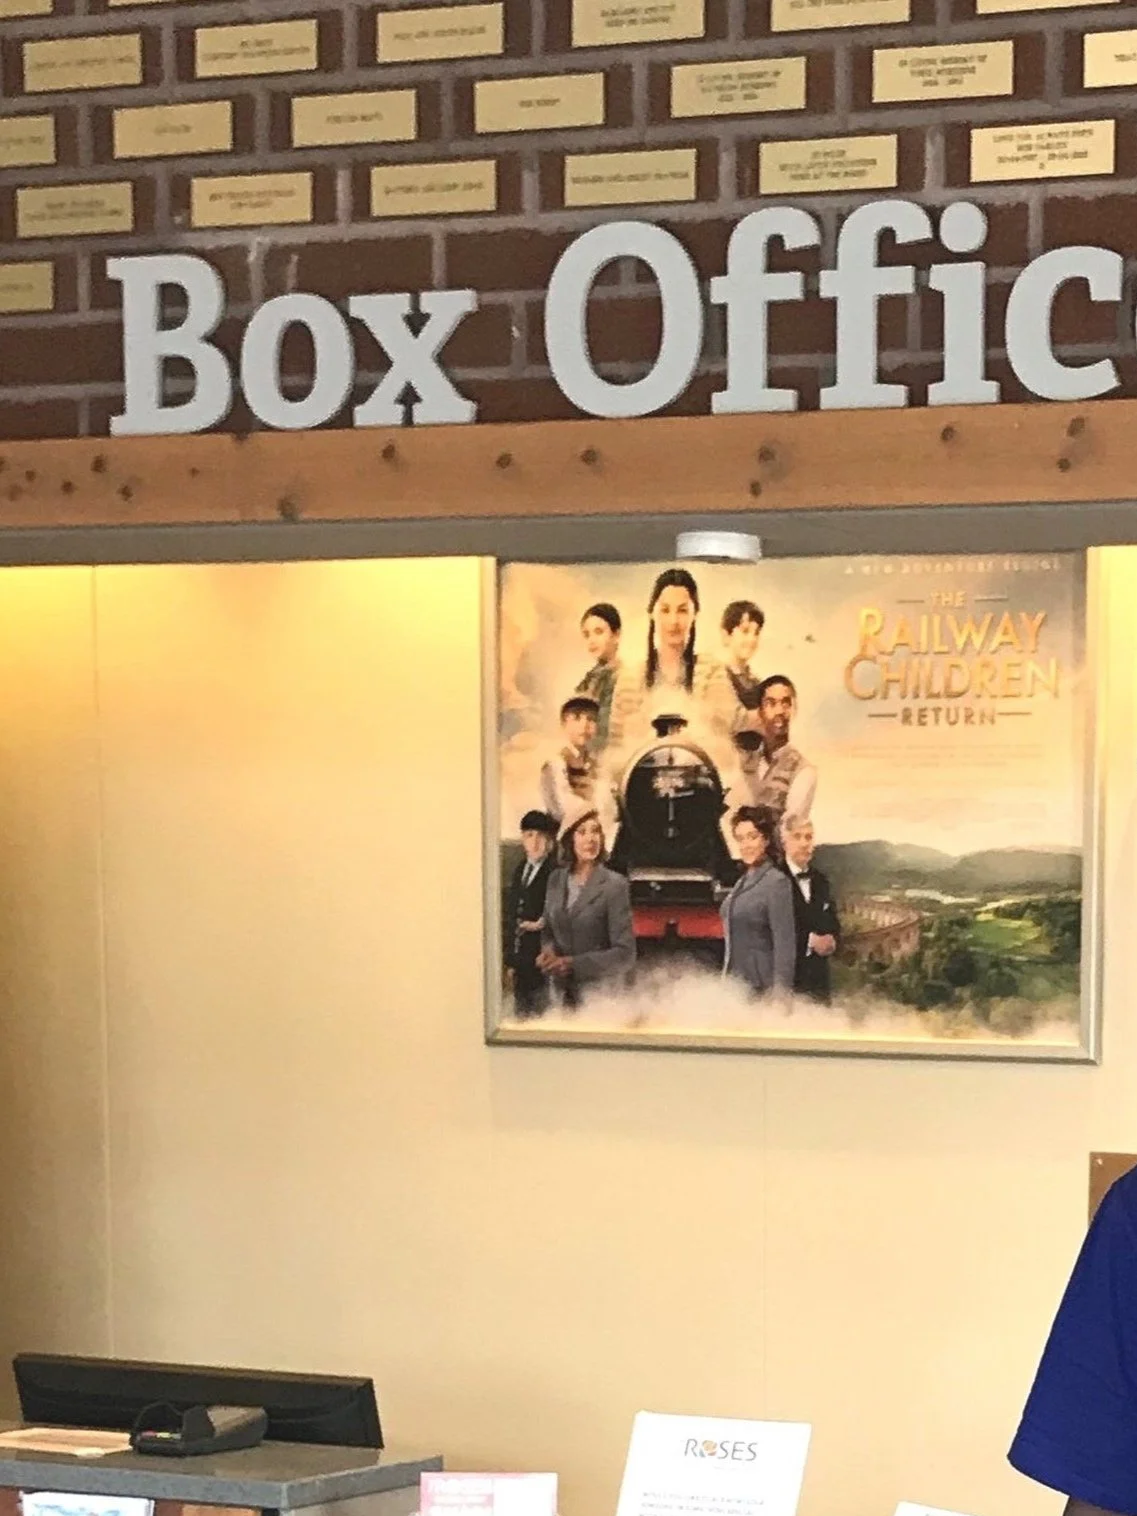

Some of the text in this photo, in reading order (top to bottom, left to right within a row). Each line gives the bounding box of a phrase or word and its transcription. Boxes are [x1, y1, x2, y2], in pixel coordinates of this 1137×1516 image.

[107, 254, 478, 436] Box
[930, 591, 967, 609] THE
[858, 607, 1047, 657] RAILWAY
[844, 656, 1060, 701] CHILDREN
[900, 705, 997, 728] RETURN
